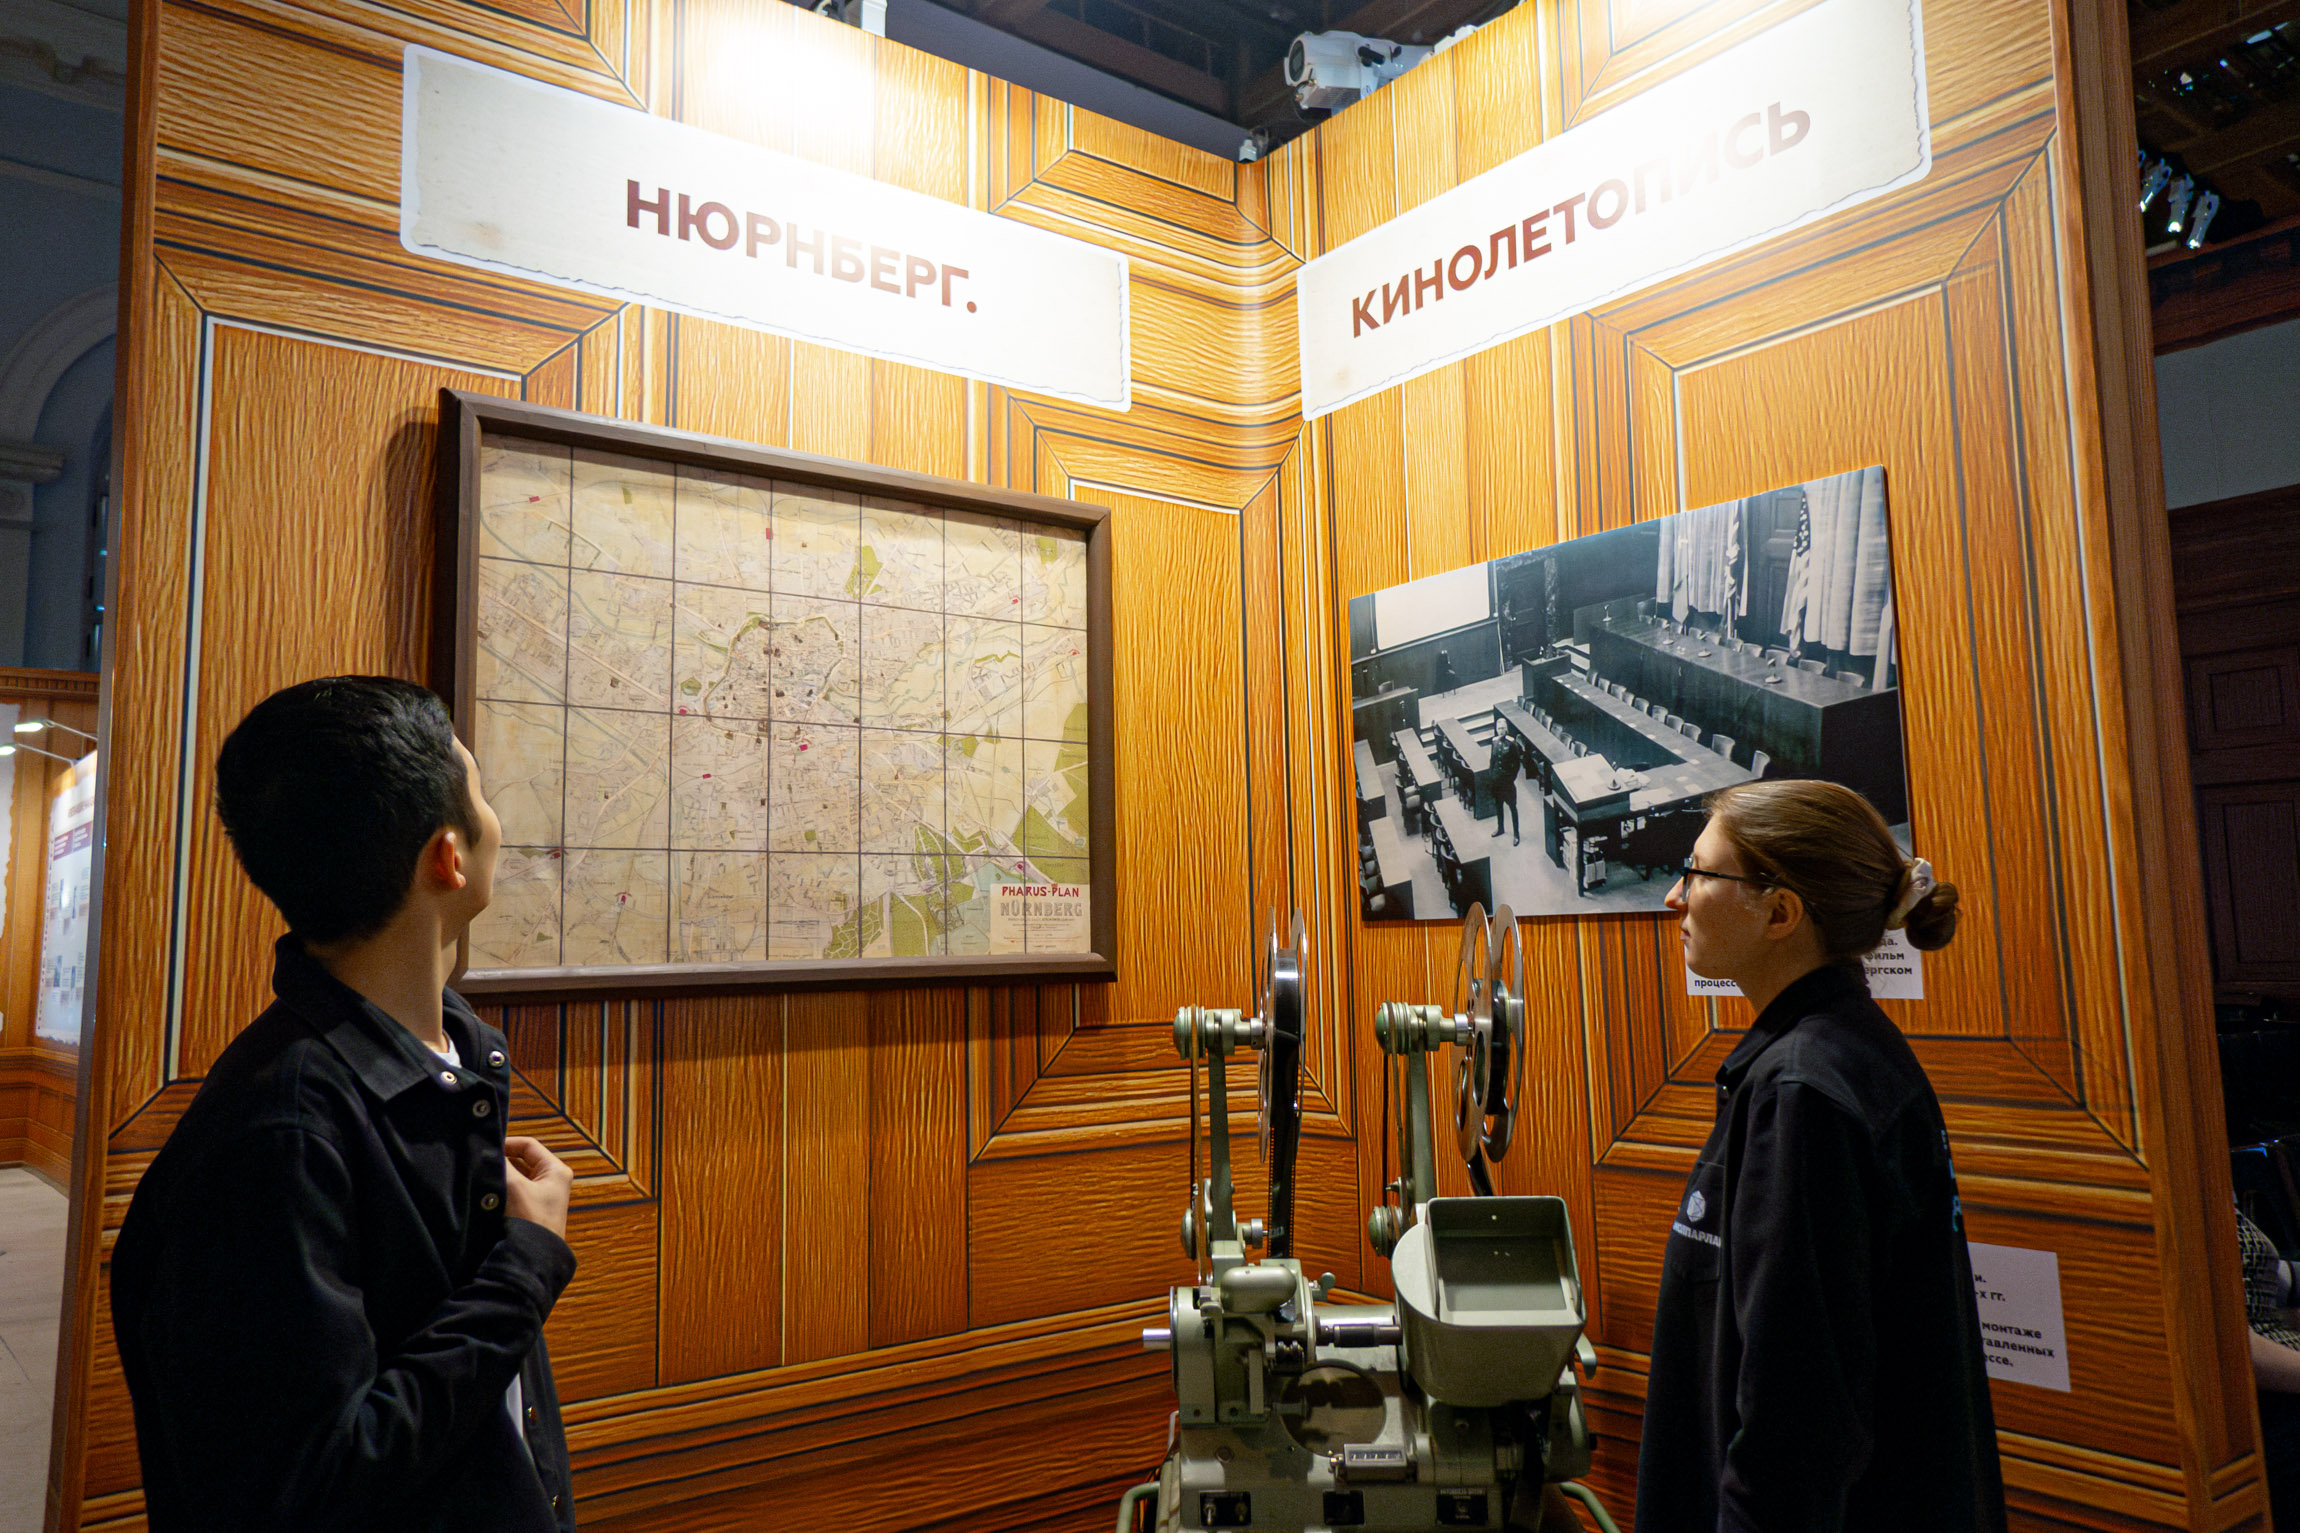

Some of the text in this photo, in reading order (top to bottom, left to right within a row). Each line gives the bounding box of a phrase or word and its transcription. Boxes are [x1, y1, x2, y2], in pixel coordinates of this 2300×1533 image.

[1352, 101, 1811, 339] КИНОЛЕТОПИСЬ
[627, 179, 977, 314] НЮРНБЕРГ.
[1002, 886, 1079, 898] PHARUS-PLAN
[1000, 900, 1083, 917] NÜRNBERG
[1865, 967, 1912, 977] ергском
[1694, 979, 1737, 989] процесс
[1982, 1322, 2042, 1339] монтаже
[1983, 1338, 2055, 1358] авленных
